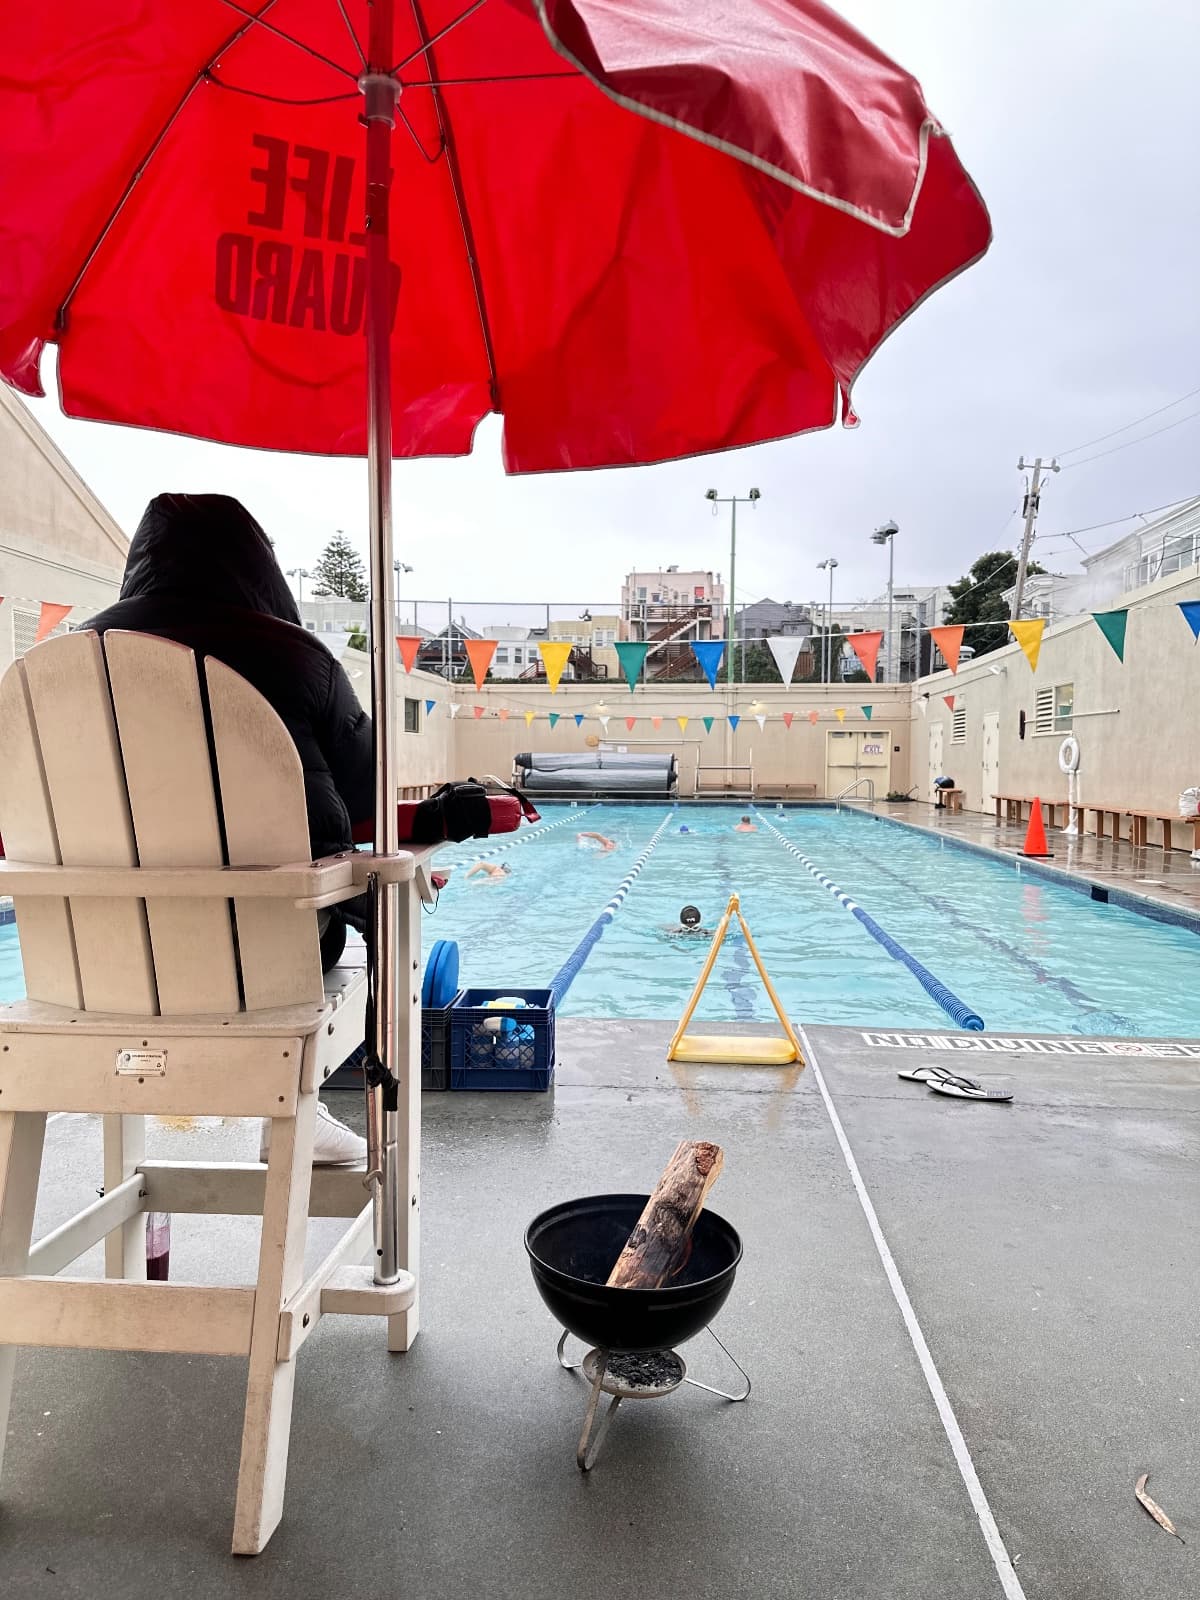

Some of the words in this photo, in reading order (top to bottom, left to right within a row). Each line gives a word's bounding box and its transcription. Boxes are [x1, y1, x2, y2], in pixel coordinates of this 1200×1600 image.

[863, 744, 880, 754] EXIT
[868, 1034, 934, 1047] NO
[945, 1037, 1109, 1054] DIVING
